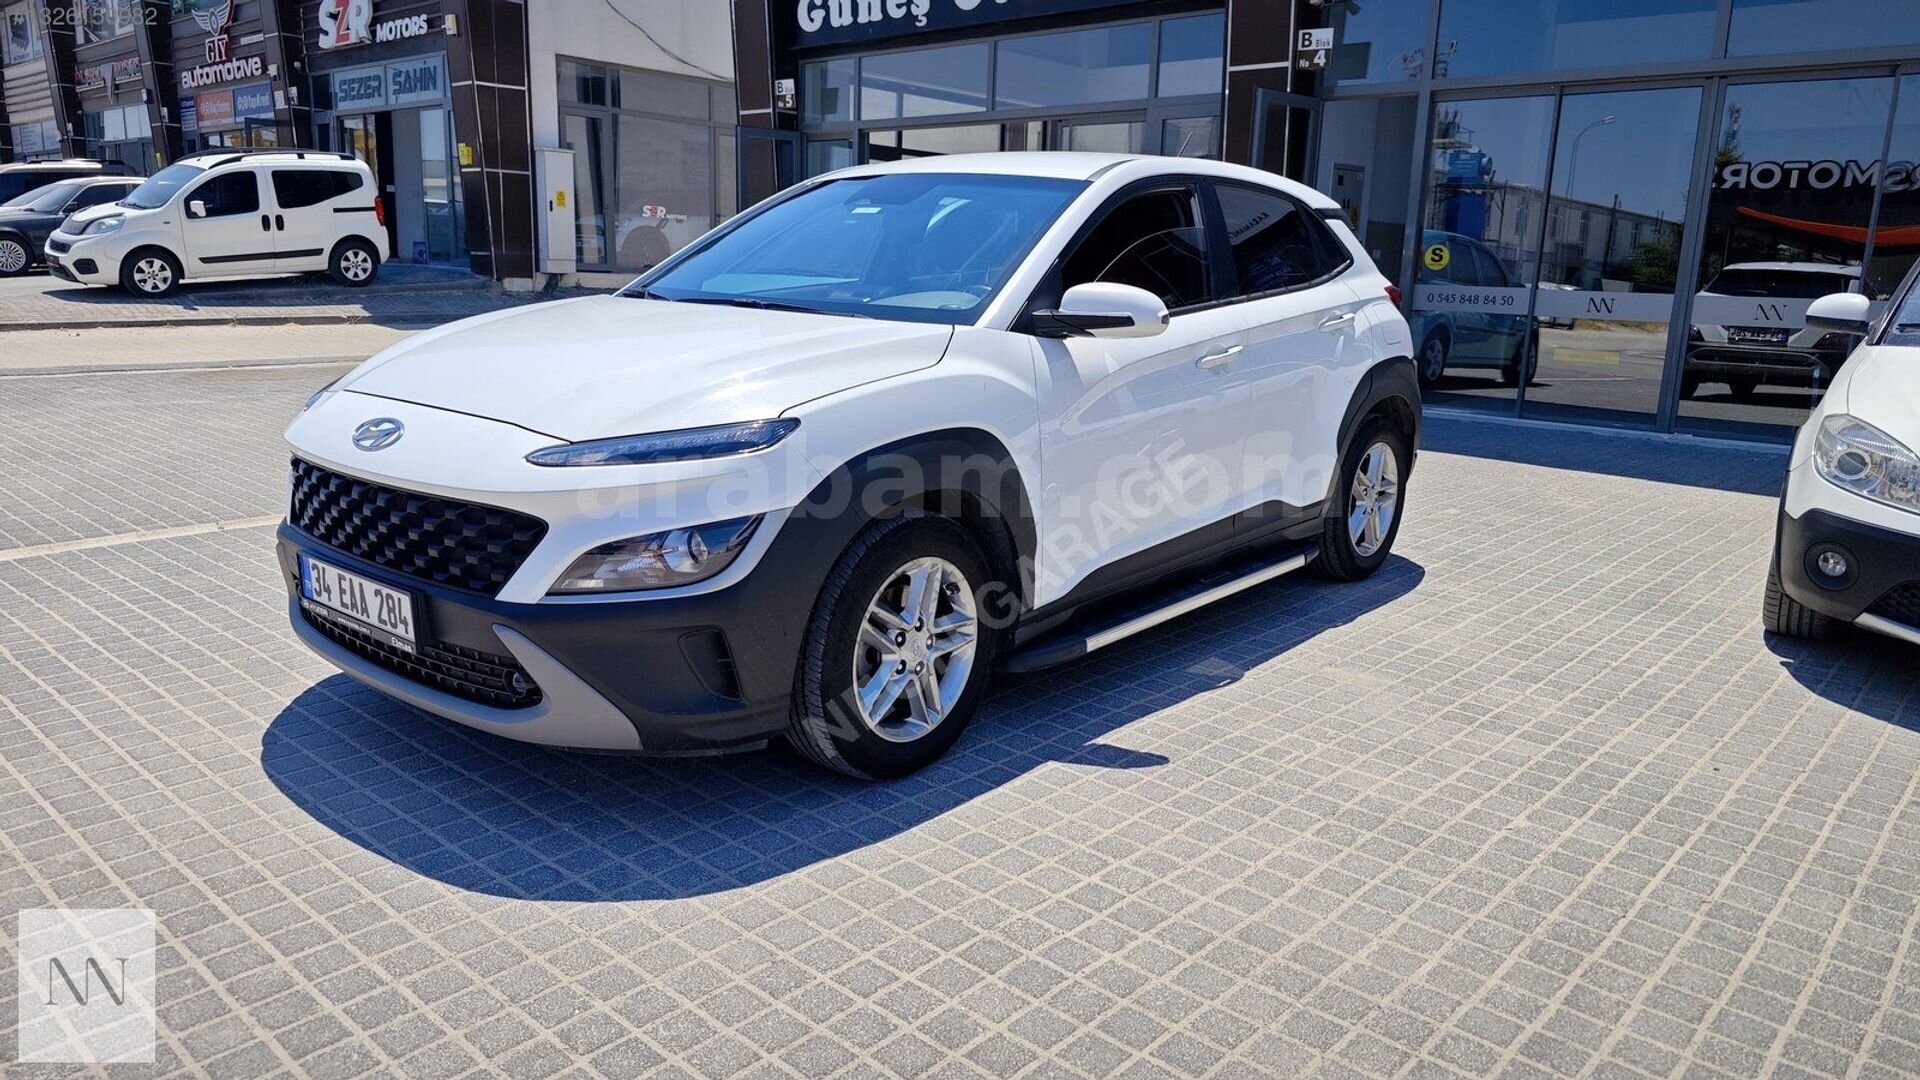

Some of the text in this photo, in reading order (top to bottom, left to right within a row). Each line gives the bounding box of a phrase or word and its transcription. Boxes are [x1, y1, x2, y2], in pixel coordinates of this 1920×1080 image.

[318, 0, 428, 49] SZR MOTORS
[1301, 31, 1312, 48] B
[1299, 50, 1326, 68] No 4
[181, 56, 262, 89] automotive
[338, 74, 383, 102] SEZER
[777, 81, 784, 94] B
[785, 95, 793, 108] 5
[1430, 247, 1444, 263] S
[1427, 292, 1515, 306] 0 545 848 84 50
[311, 563, 409, 635] 34 EAA 284
